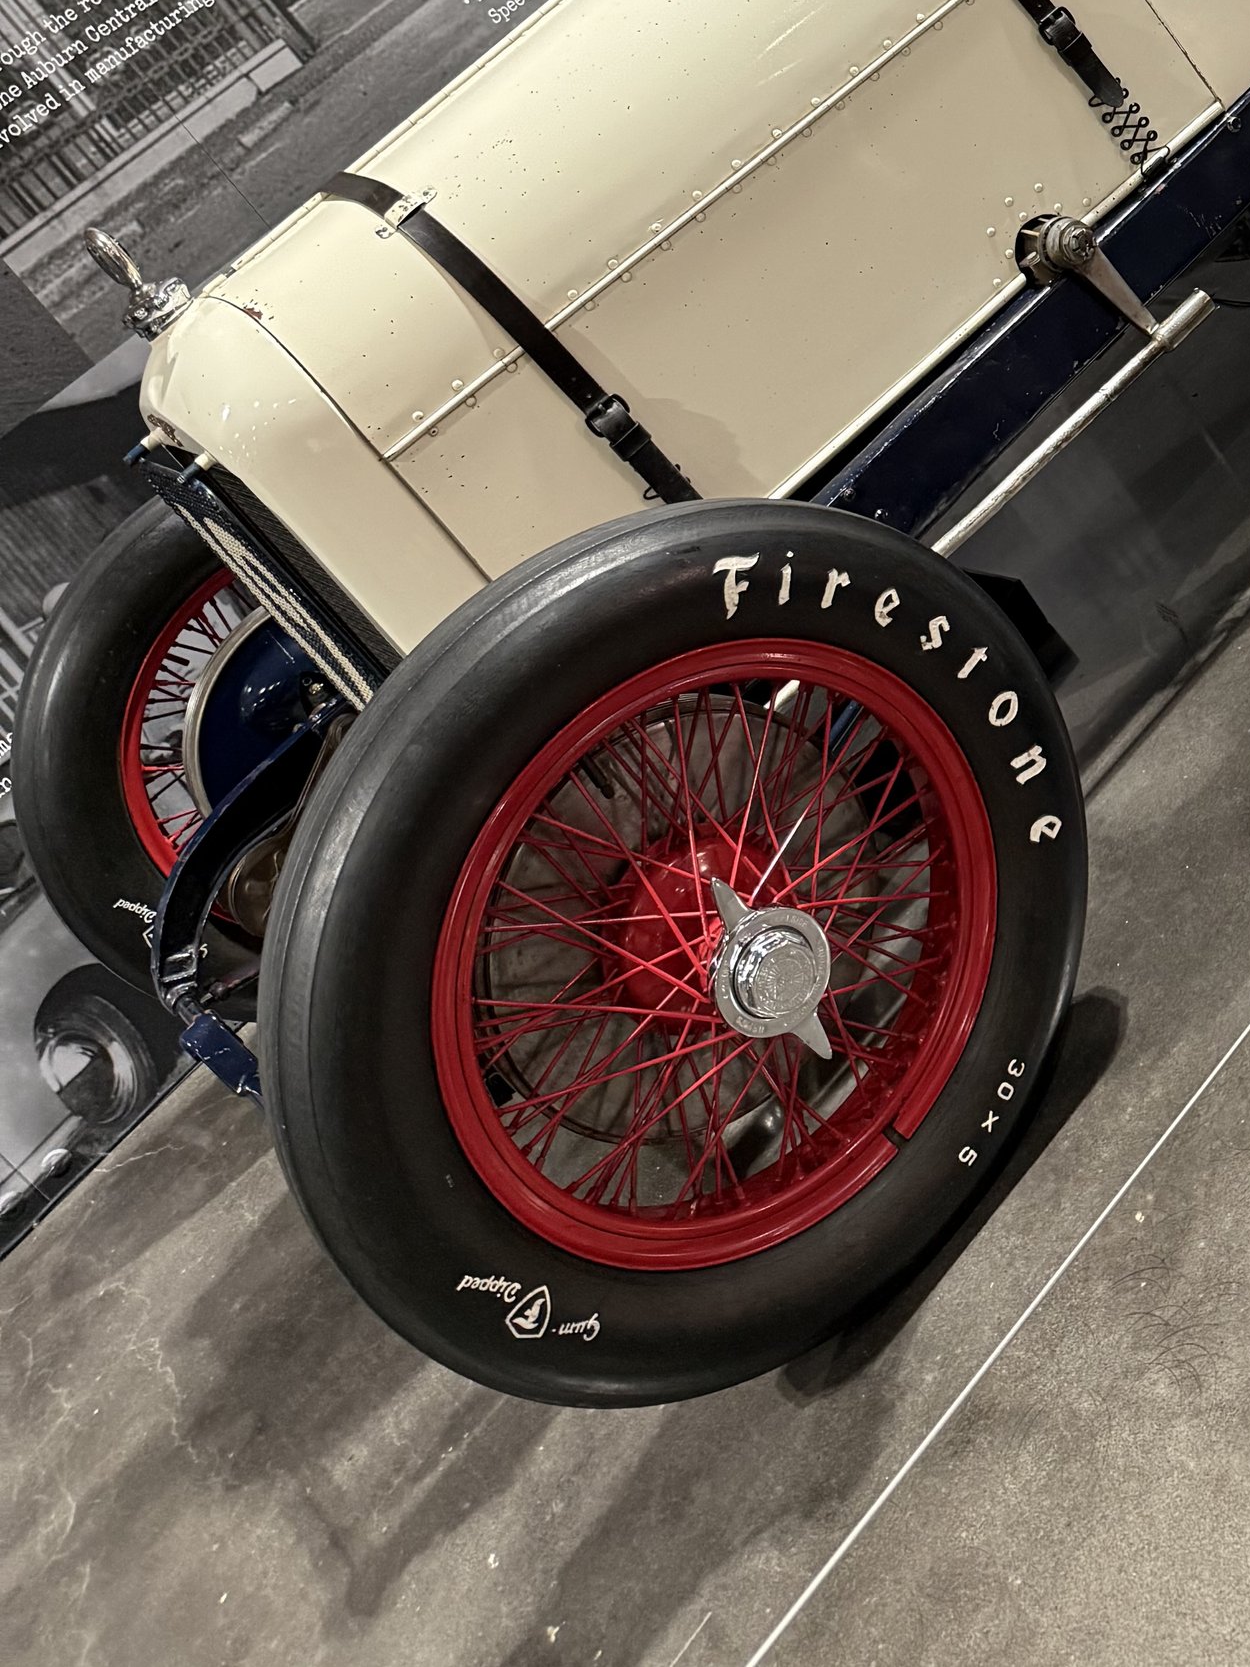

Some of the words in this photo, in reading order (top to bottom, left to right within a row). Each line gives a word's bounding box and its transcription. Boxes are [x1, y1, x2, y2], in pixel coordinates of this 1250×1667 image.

[43, 8, 77, 32] the
[21, 40, 88, 88] Auburn
[712, 550, 1064, 844] Firestone
[112, 898, 157, 924] Dipped
[958, 1146, 978, 1166] 5
[456, 1275, 522, 1303] Dipped
